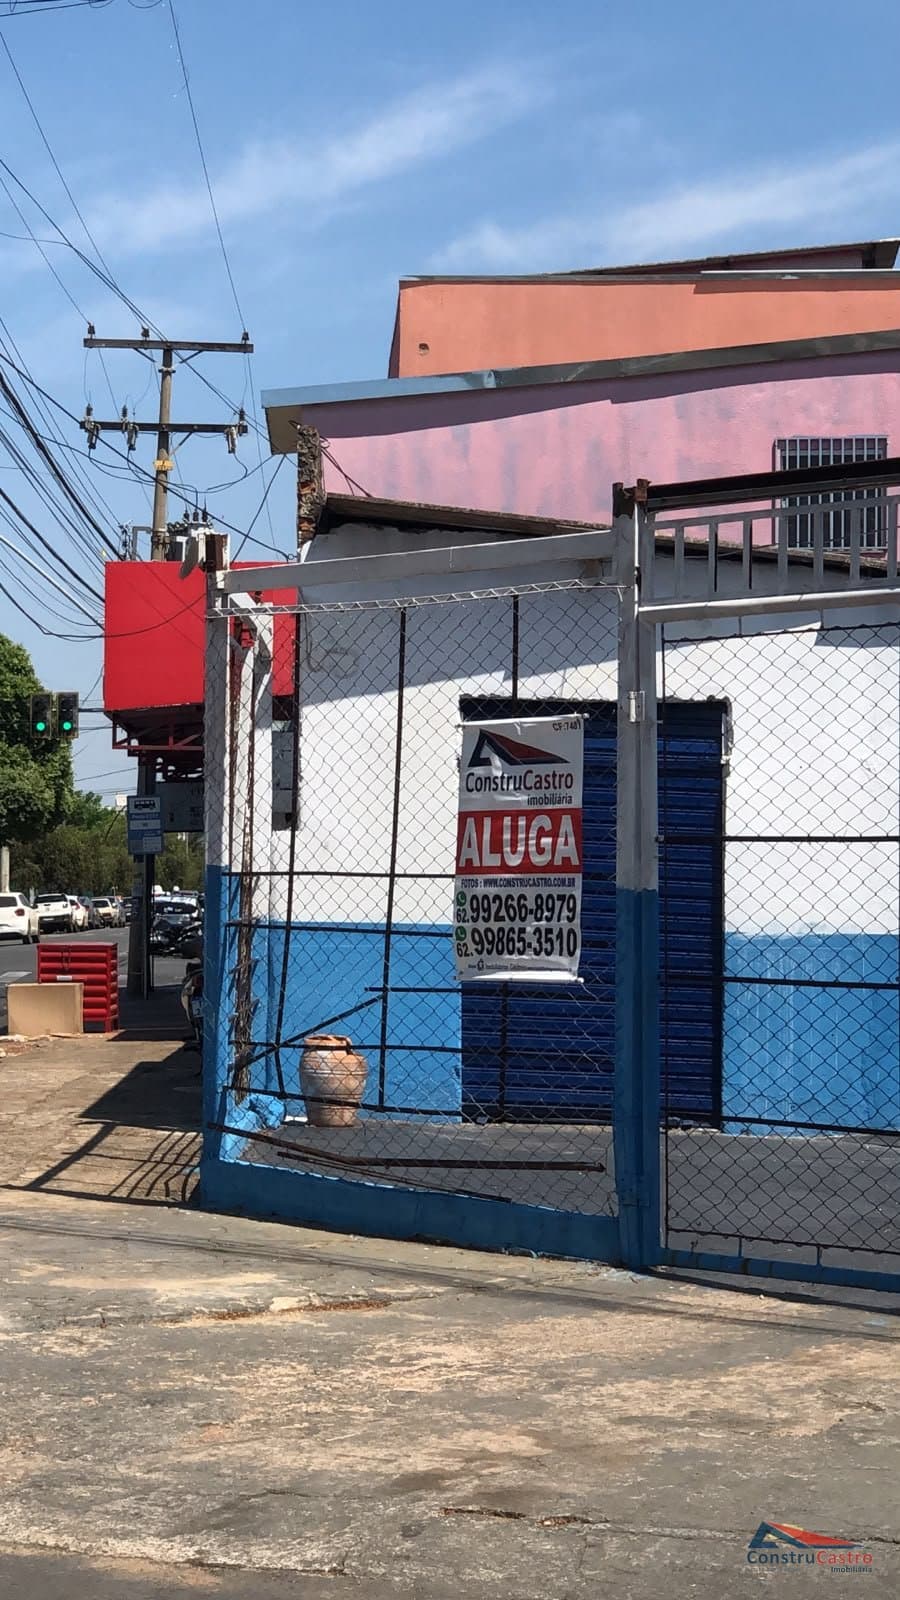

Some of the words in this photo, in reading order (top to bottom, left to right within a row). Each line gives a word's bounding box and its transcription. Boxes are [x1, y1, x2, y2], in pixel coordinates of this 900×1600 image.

[465, 769, 574, 793] ConstruCastro
[527, 793, 573, 806] imobiliária
[458, 814, 580, 867] ALUGA
